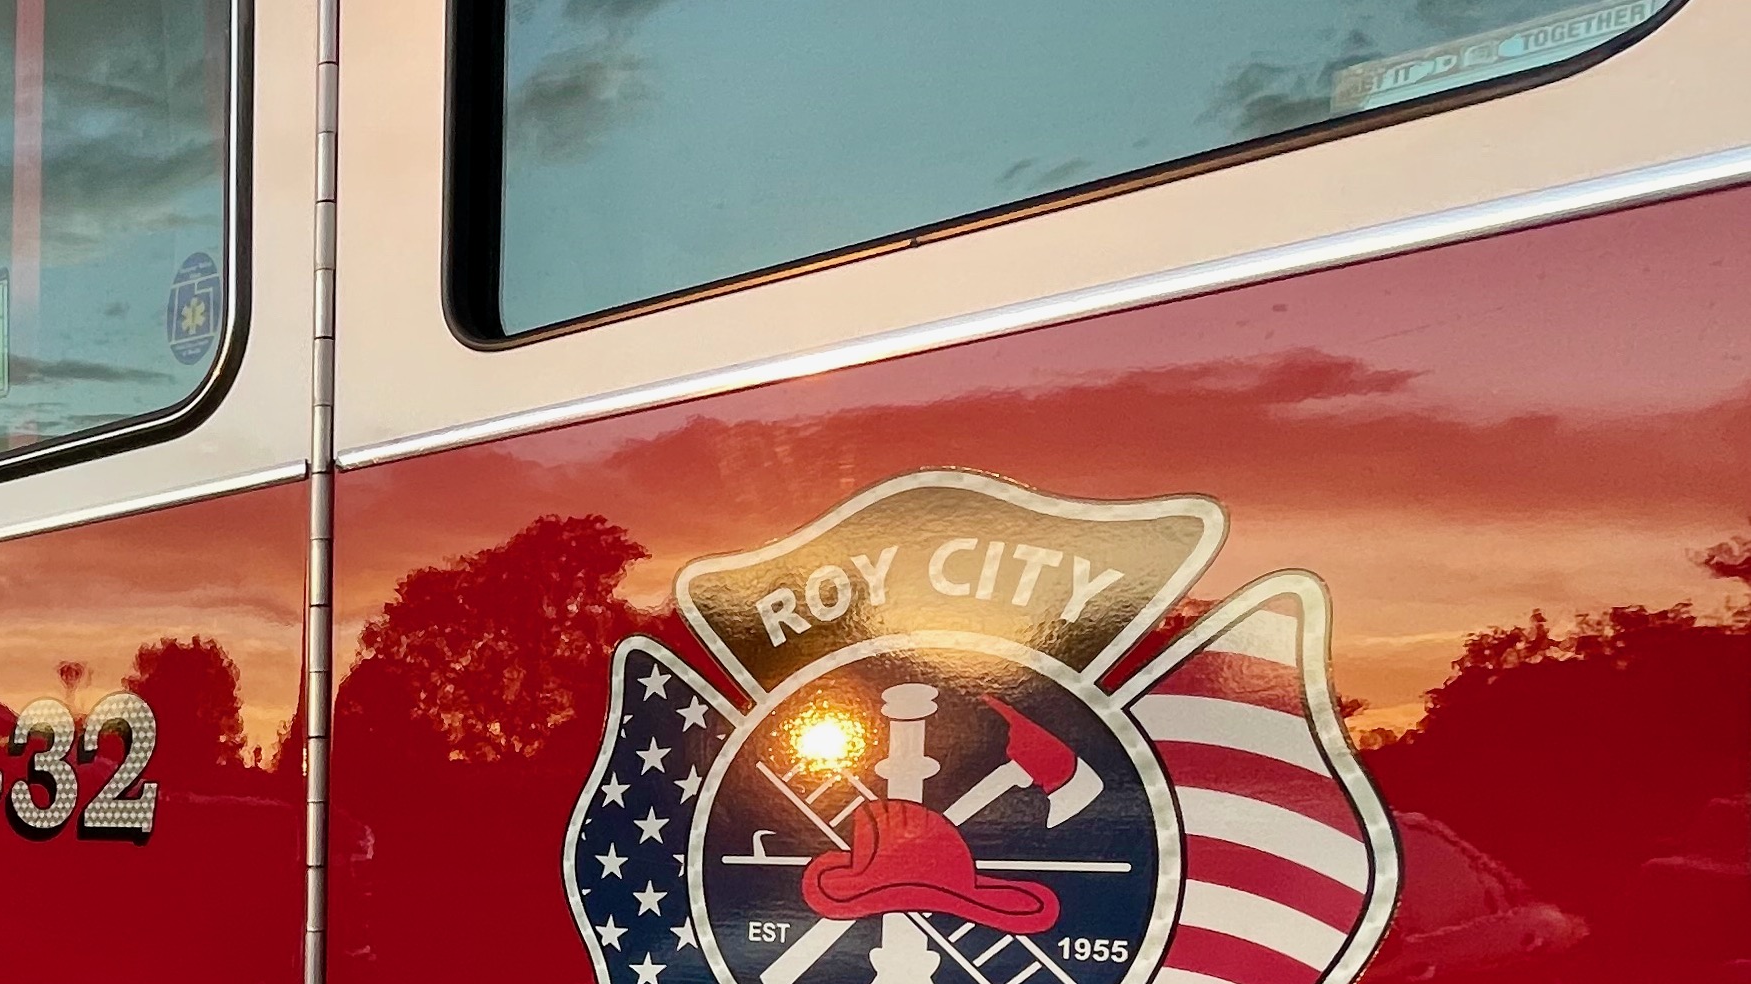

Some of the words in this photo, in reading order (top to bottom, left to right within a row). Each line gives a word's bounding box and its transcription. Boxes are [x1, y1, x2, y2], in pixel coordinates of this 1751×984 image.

[1521, 3, 1646, 50] TOGETHER
[756, 545, 900, 648] ROY
[928, 537, 1125, 622] CITY
[748, 921, 791, 945] EST
[1056, 936, 1129, 964] 1955
